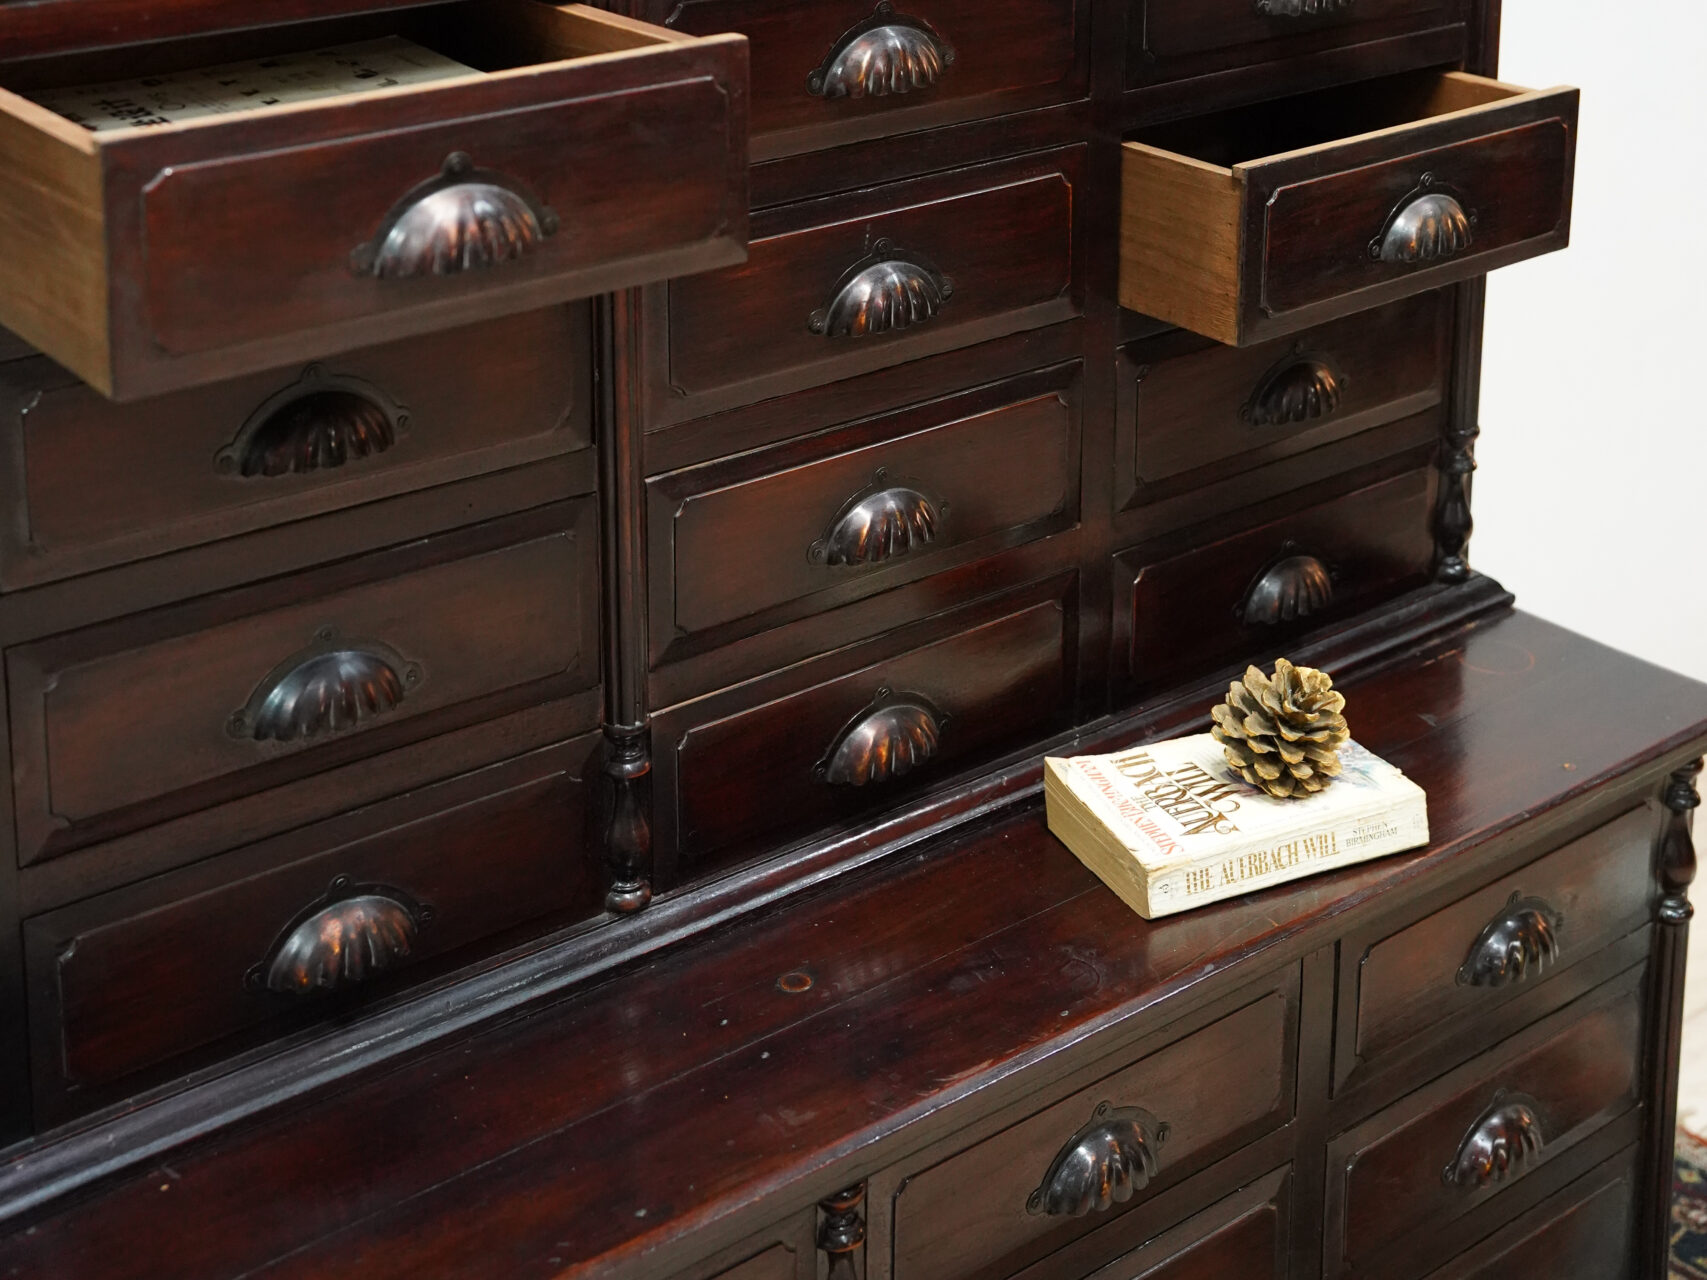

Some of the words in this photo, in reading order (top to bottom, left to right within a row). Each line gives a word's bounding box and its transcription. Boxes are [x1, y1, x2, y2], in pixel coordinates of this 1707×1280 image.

[1110, 752, 1241, 836] AUERBACH
[1166, 762, 1240, 813] WILL
[1186, 866, 1215, 895] THE
[1219, 841, 1299, 886] AUERBACH
[1303, 832, 1339, 860] WILL
[1346, 827, 1397, 847] BIRMINGHAM
